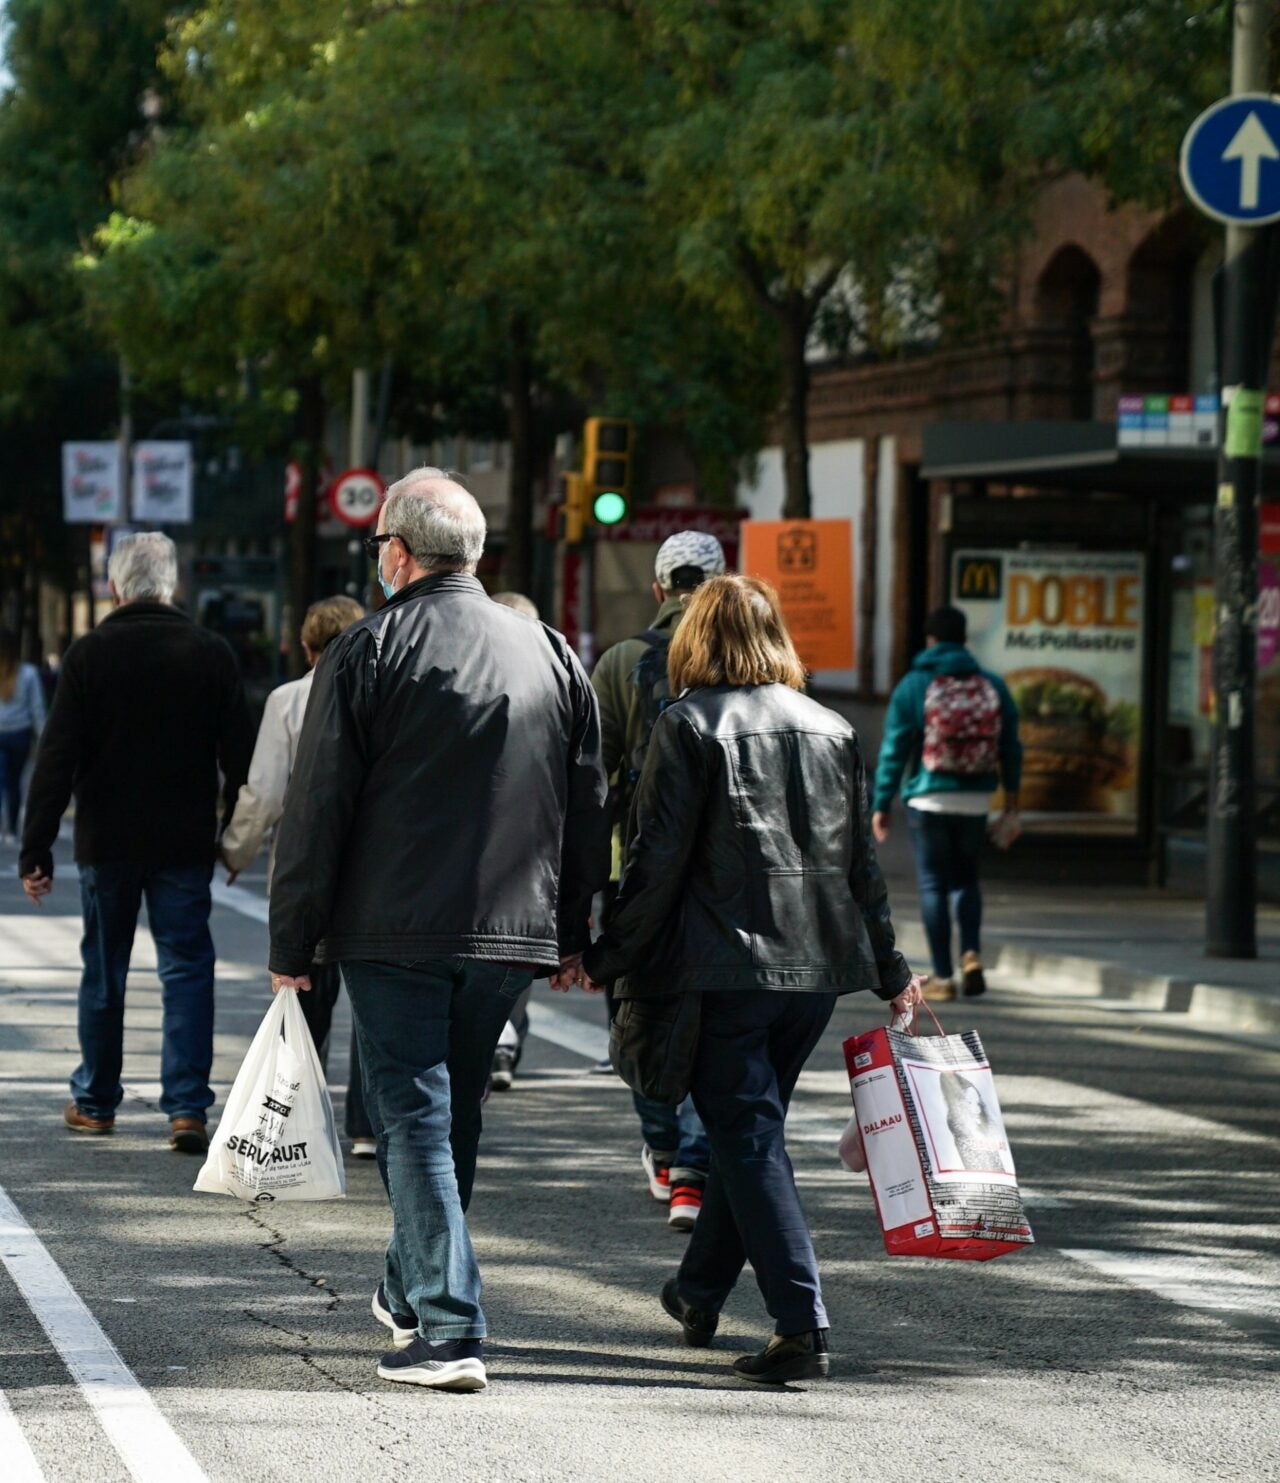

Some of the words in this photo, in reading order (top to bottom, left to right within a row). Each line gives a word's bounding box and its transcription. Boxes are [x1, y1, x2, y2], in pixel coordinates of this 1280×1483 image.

[344, 486, 374, 507] 30
[1007, 573, 1139, 629] DOBLE
[1005, 630, 1136, 652] McPollastre
[863, 1114, 902, 1134] DALMAU
